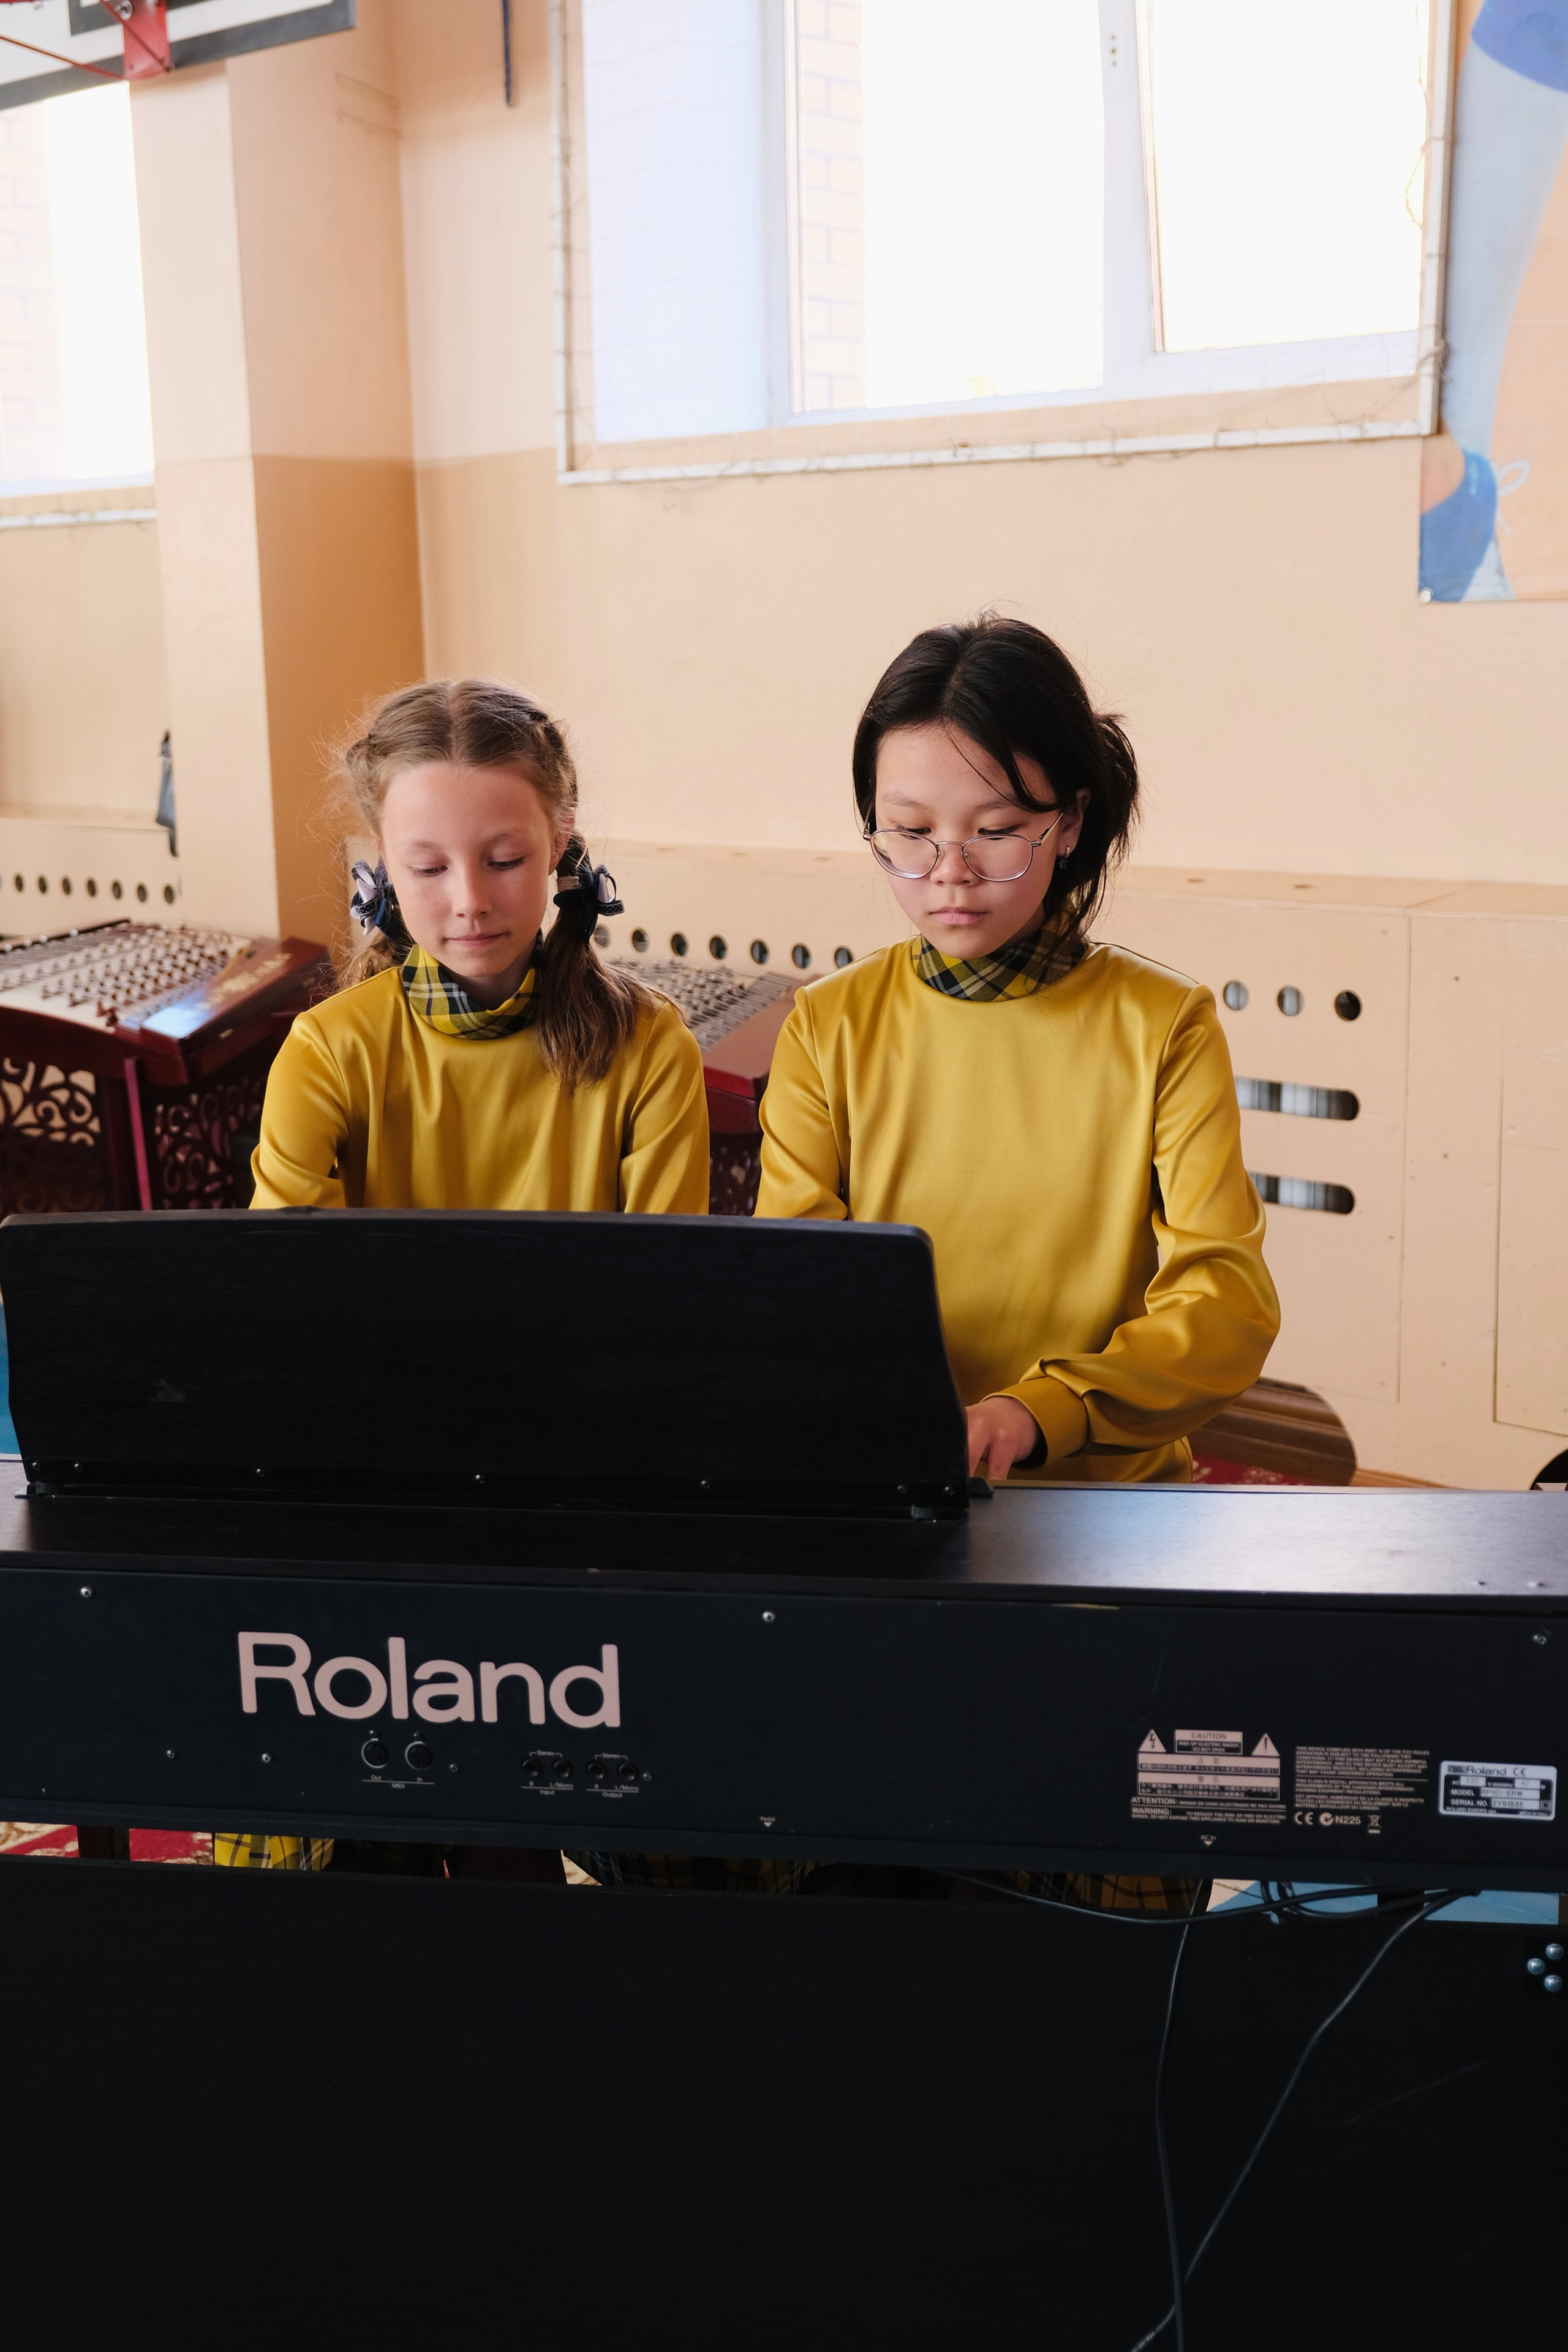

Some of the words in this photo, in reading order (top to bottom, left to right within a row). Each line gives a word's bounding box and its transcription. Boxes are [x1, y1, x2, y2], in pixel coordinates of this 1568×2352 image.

[238, 1630, 621, 1728] Roland
[1466, 1765, 1507, 1776] Roland
[1132, 1796, 1178, 1805] ATTENTION:
[1335, 1815, 1361, 1825] N225
